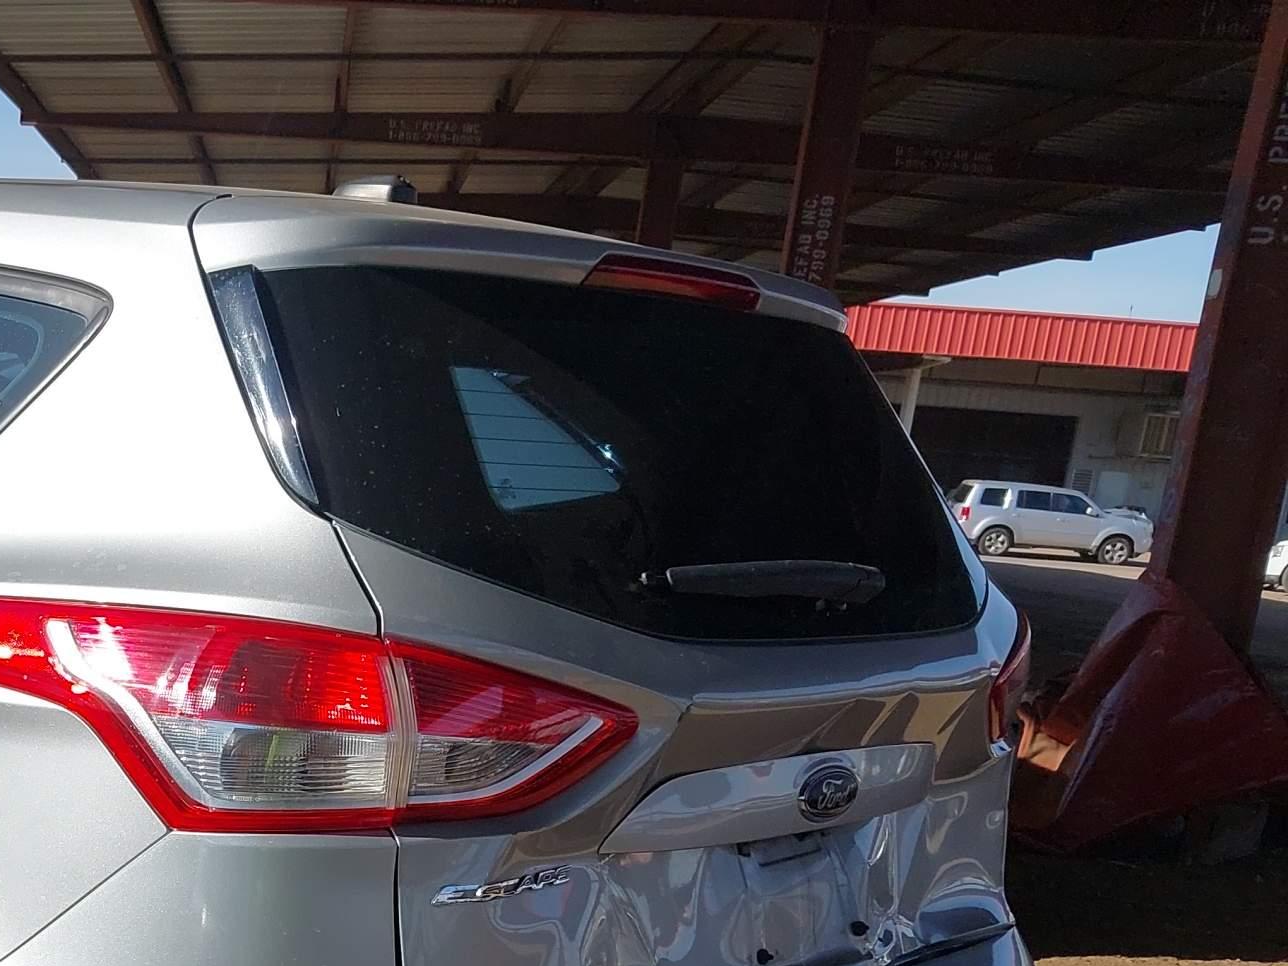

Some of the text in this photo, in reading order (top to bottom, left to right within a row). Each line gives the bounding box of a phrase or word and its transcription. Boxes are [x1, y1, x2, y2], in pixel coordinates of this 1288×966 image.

[793, 193, 819, 280] EFAB INC.
[808, 195, 835, 283] 799-0969
[1247, 185, 1287, 244] U.S.
[817, 779, 856, 810] Ford
[431, 864, 573, 906] ESCAPE
